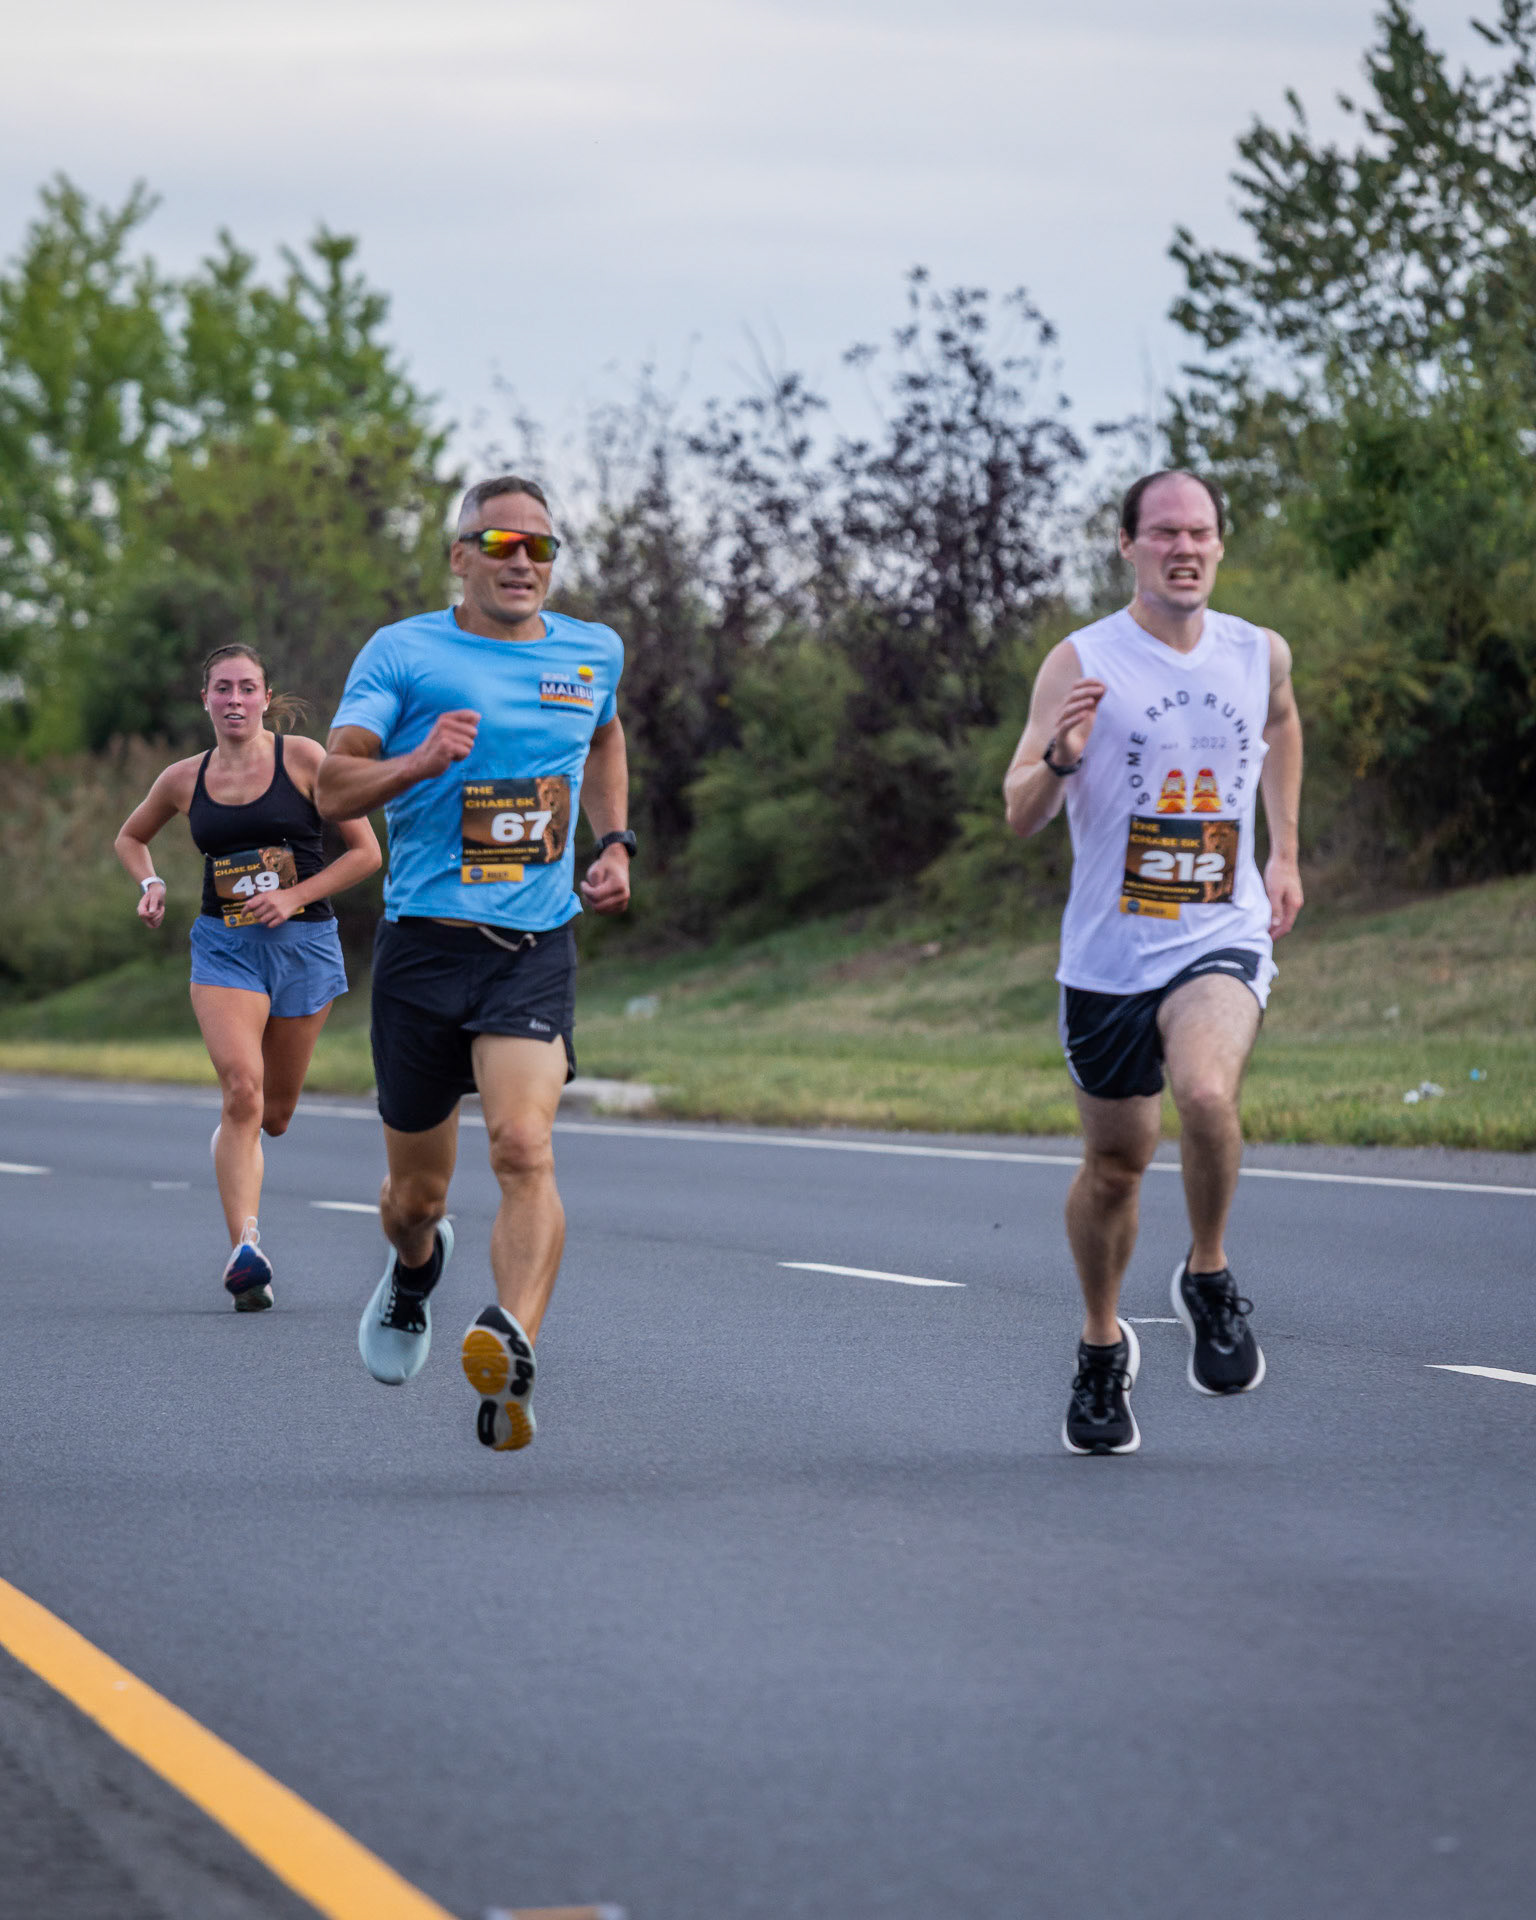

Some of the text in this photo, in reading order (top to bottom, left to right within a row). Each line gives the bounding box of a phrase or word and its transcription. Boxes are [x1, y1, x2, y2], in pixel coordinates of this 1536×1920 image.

[541, 682, 593, 700] MALIBU
[1127, 690, 1249, 807] SOME RAD RUNNERS
[465, 786, 494, 796] THE
[465, 797, 536, 808] CHASE 5K
[491, 810, 552, 843] 67
[215, 859, 231, 867] THE
[215, 863, 261, 877] CHASE 5K
[1139, 850, 1226, 882] 212
[232, 871, 280, 897] 49
